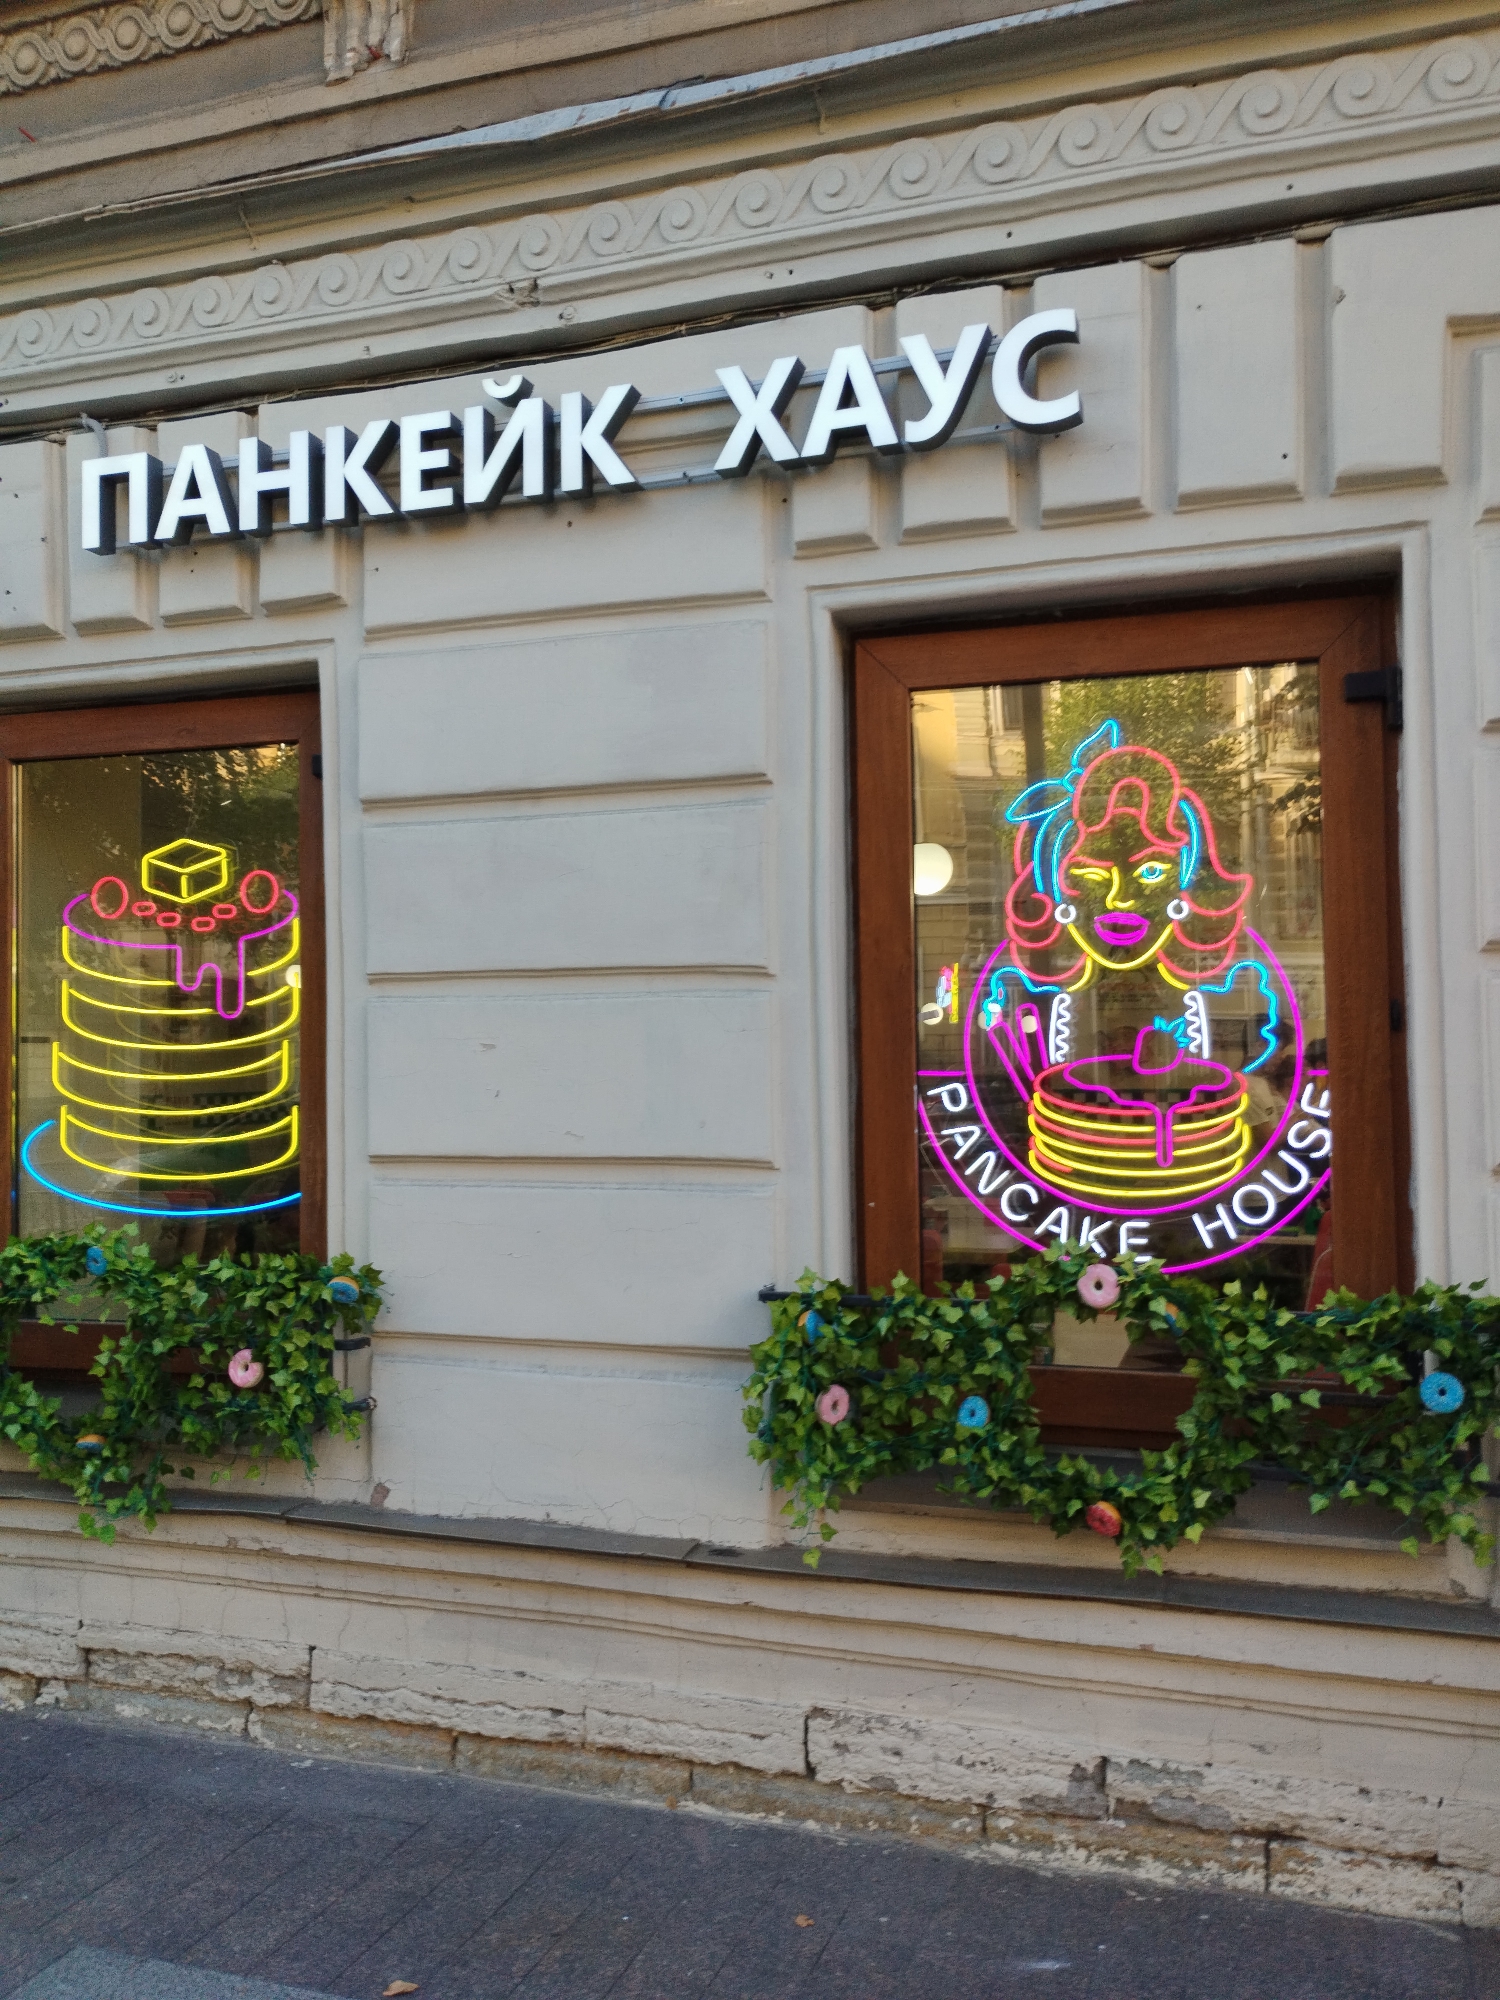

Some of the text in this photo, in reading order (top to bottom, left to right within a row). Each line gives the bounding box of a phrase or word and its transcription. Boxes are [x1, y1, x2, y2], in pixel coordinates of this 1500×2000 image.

[81, 308, 1083, 554] ПАНКЕЙК ХАУС
[926, 1081, 1332, 1263] PANCAKE HOUSE
